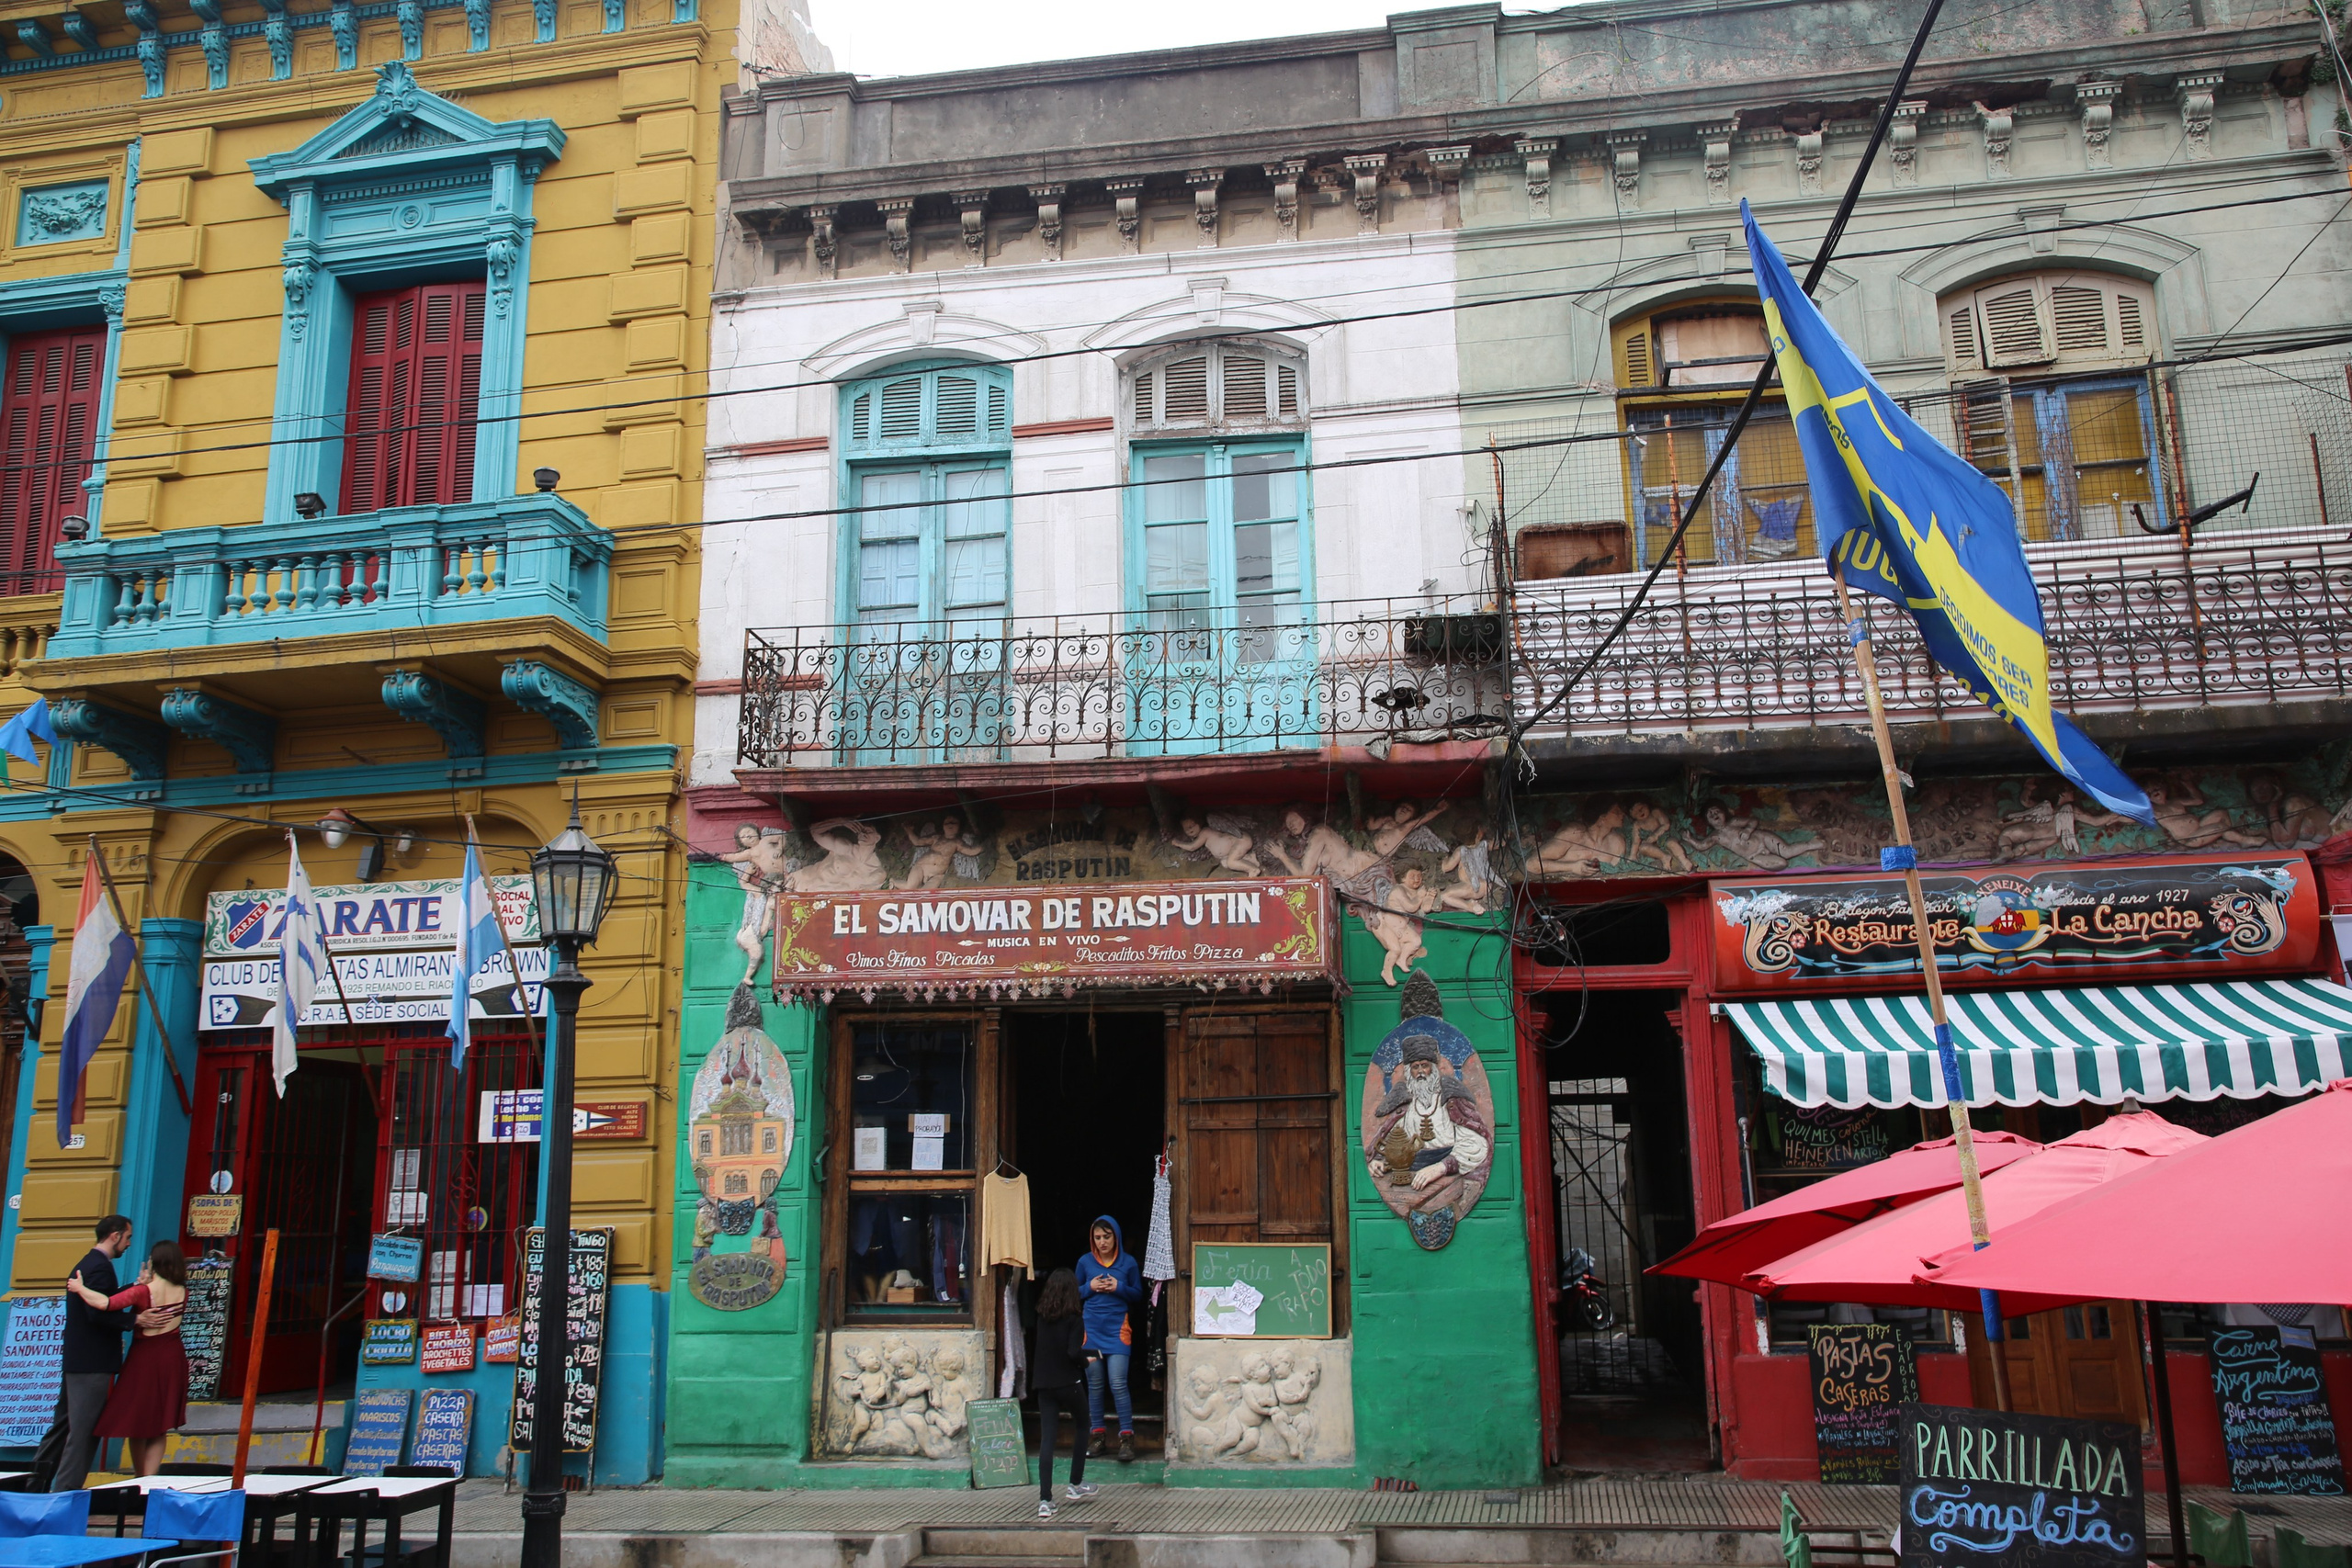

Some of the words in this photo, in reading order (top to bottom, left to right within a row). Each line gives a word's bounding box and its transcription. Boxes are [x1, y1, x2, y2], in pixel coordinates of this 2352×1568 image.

[1939, 584, 1996, 665] DECIDIMOS
[2001, 654, 2033, 690] SER
[1016, 856, 1131, 881] RASPUTIN
[495, 890, 531, 902] SOCIAL
[1975, 879, 2033, 899] XENEIXE
[2100, 891, 2115, 905] el
[2155, 889, 2190, 903] 1927
[833, 904, 867, 935] EL
[878, 899, 1033, 935] SAMOVAR
[1042, 897, 1082, 930] DE
[1091, 892, 1261, 928] RASPUTIN
[231, 906, 266, 940] ZARATE
[2051, 906, 2089, 936] La
[2093, 904, 2203, 941] Cancha
[987, 936, 1031, 948] MUSICA
[1038, 936, 1057, 947] EN
[1066, 934, 1101, 946] VIVO
[846, 951, 885, 968] Vinos
[888, 949, 927, 968] Finos
[935, 951, 995, 967] Picadas
[1074, 946, 1146, 963] Pescaditos
[1147, 942, 1186, 963] Fritos
[1193, 942, 1243, 960] Pizza
[209, 964, 254, 986] CLUB
[259, 963, 280, 984] DE
[480, 950, 547, 975] BROWN
[342, 982, 363, 993] 1925
[366, 981, 412, 993] REMANDO
[414, 981, 425, 991] EL
[356, 1005, 392, 1020] SEDE
[397, 1003, 448, 1019] SOCIAL
[523, 1093, 544, 1104] con
[500, 1104, 530, 1114] Leche
[1784, 1119, 1837, 1144] QUILMES
[1785, 1139, 1852, 1163] HEINEKEN
[1853, 1125, 1889, 1147] STELLA
[1853, 1145, 1888, 1161] ARTOIS
[196, 1199, 220, 1207] SOPAS
[223, 1198, 233, 1207] DE
[373, 1239, 400, 1250] Chocolate
[390, 1249, 413, 1259] Churros
[713, 1257, 775, 1281] SAMOVAR
[1201, 1251, 1273, 1281] Feria
[214, 1269, 229, 1280] DIA
[729, 1277, 741, 1287] DE
[1287, 1258, 1328, 1293] TODO
[701, 1280, 772, 1307] RASPUTIN
[15, 1314, 51, 1326] TANGO
[429, 1330, 451, 1341] BIFE
[455, 1328, 469, 1339] DE
[425, 1337, 471, 1350] CHORIZO
[2212, 1330, 2280, 1364] Carne
[423, 1347, 473, 1359] BROCHETTES
[1816, 1335, 1895, 1383] PASTAS
[426, 1357, 470, 1369] VEGETALES
[2211, 1359, 2321, 1404] Argentina
[358, 1395, 407, 1406] SANDWICHS
[429, 1395, 466, 1411] PIZZA
[1819, 1377, 1891, 1413] CASERAS
[358, 1412, 401, 1423] MARISCOS
[424, 1411, 464, 1427] CASERA
[422, 1427, 463, 1443] PASTAS
[416, 1443, 462, 1459] CASERAS
[1915, 1422, 2133, 1497] PARRILLADA
[1909, 1483, 2136, 1553] Completa
